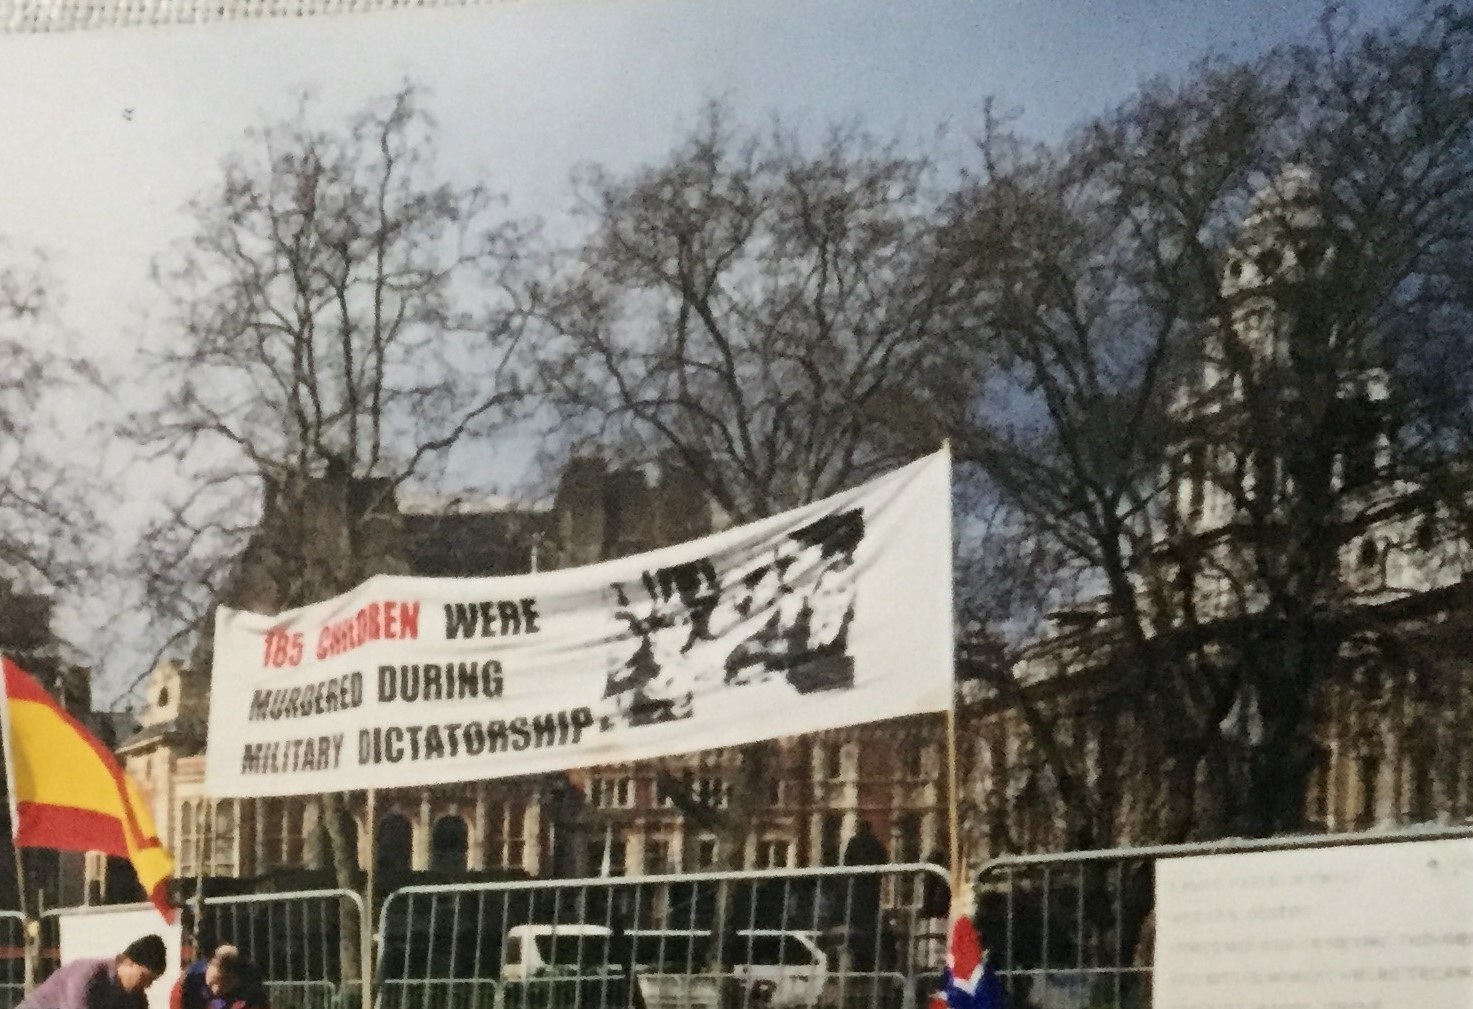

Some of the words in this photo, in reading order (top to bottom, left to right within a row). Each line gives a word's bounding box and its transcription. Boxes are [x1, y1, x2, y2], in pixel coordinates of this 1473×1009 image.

[263, 626, 304, 668] 185
[317, 601, 421, 660] CHILDREN
[445, 599, 541, 640] WERE
[249, 671, 363, 721] MURDERED
[378, 660, 504, 702] DURING
[241, 733, 344, 775] MILITARY
[359, 706, 594, 765] DICTATORSHIP
